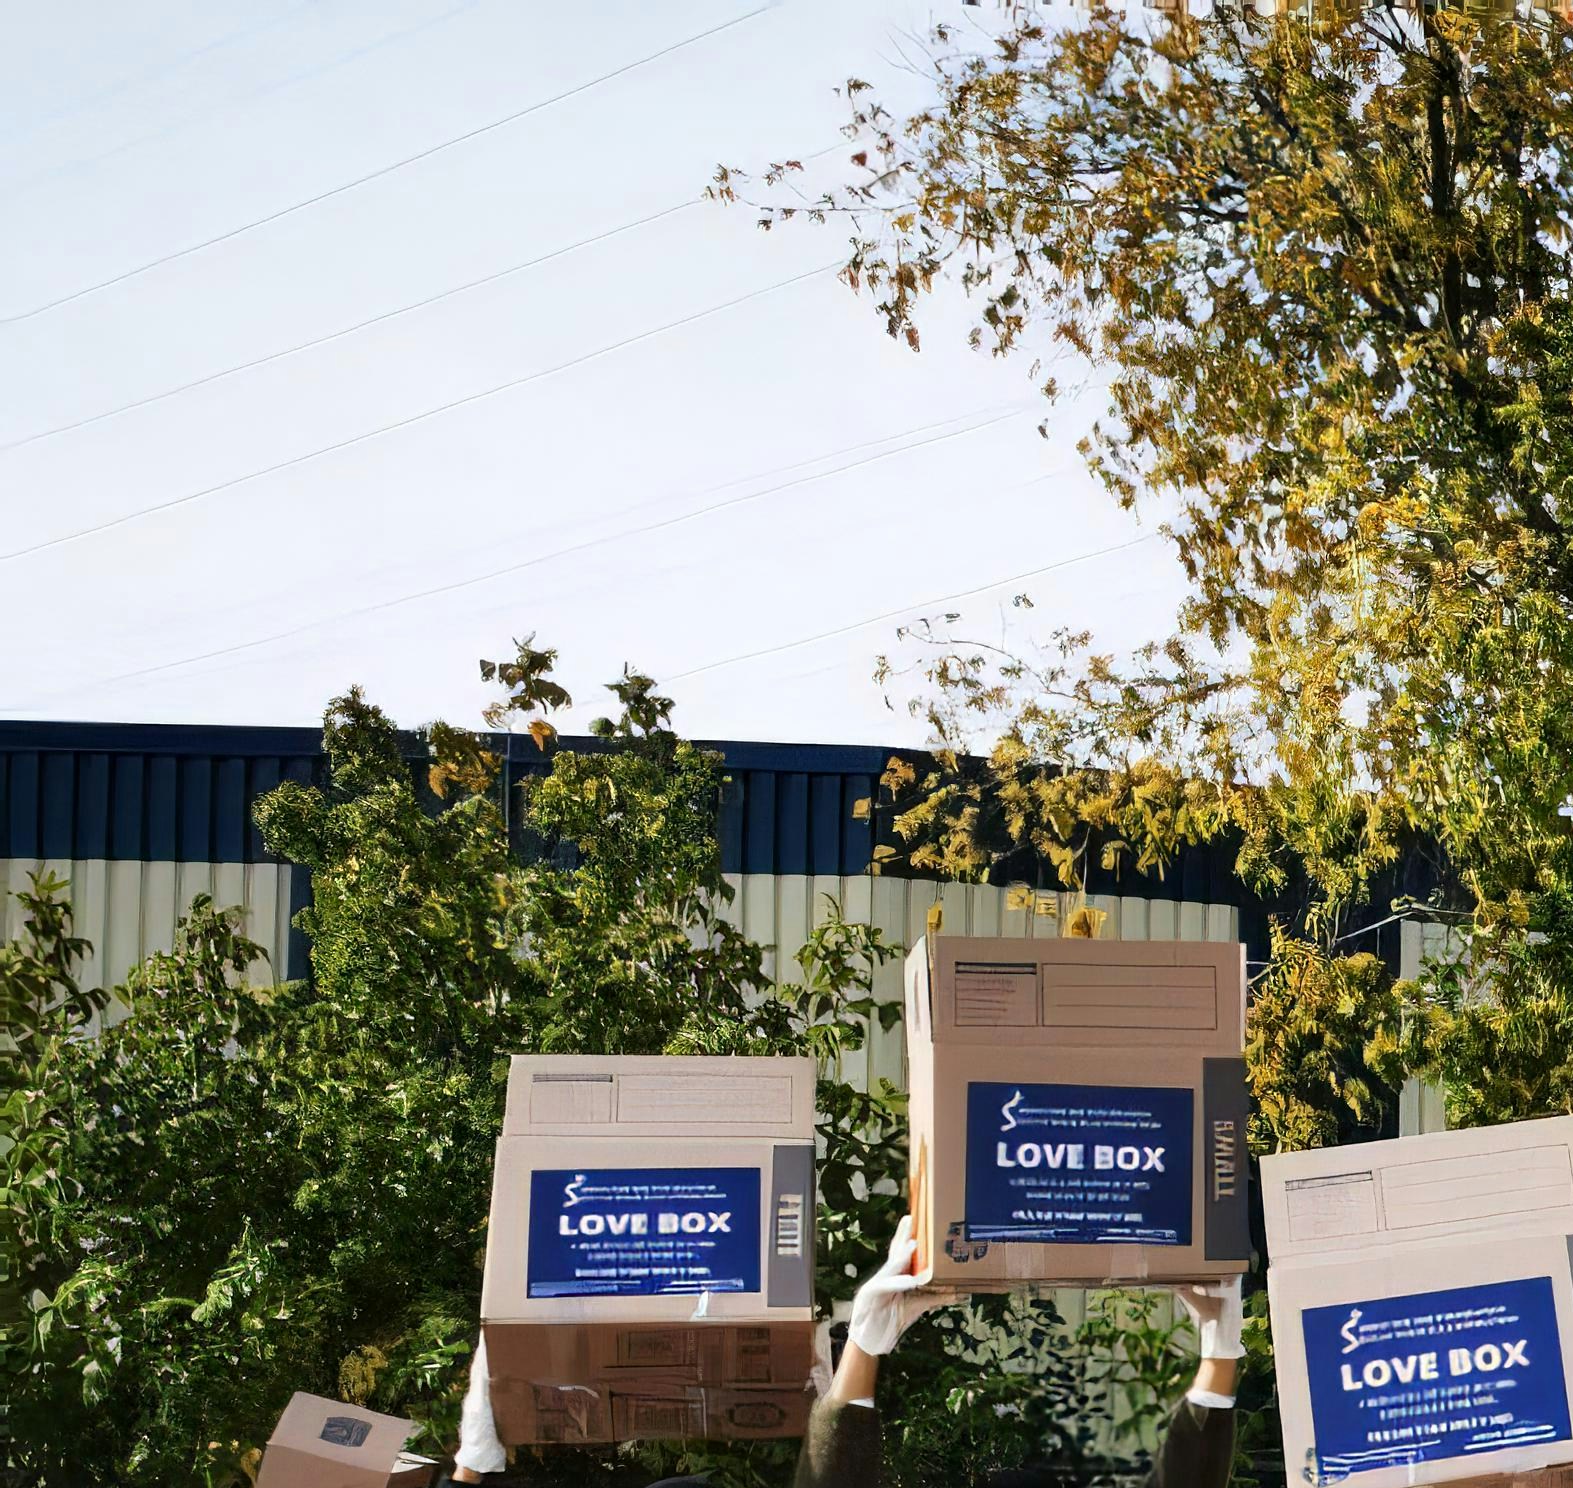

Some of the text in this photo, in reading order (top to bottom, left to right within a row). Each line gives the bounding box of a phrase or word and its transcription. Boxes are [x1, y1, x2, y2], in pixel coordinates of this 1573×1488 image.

[996, 1141, 1166, 1173] LOVE BOX
[558, 1211, 731, 1236] LOVE BOX
[1340, 1339, 1531, 1392] LOVE BOX
